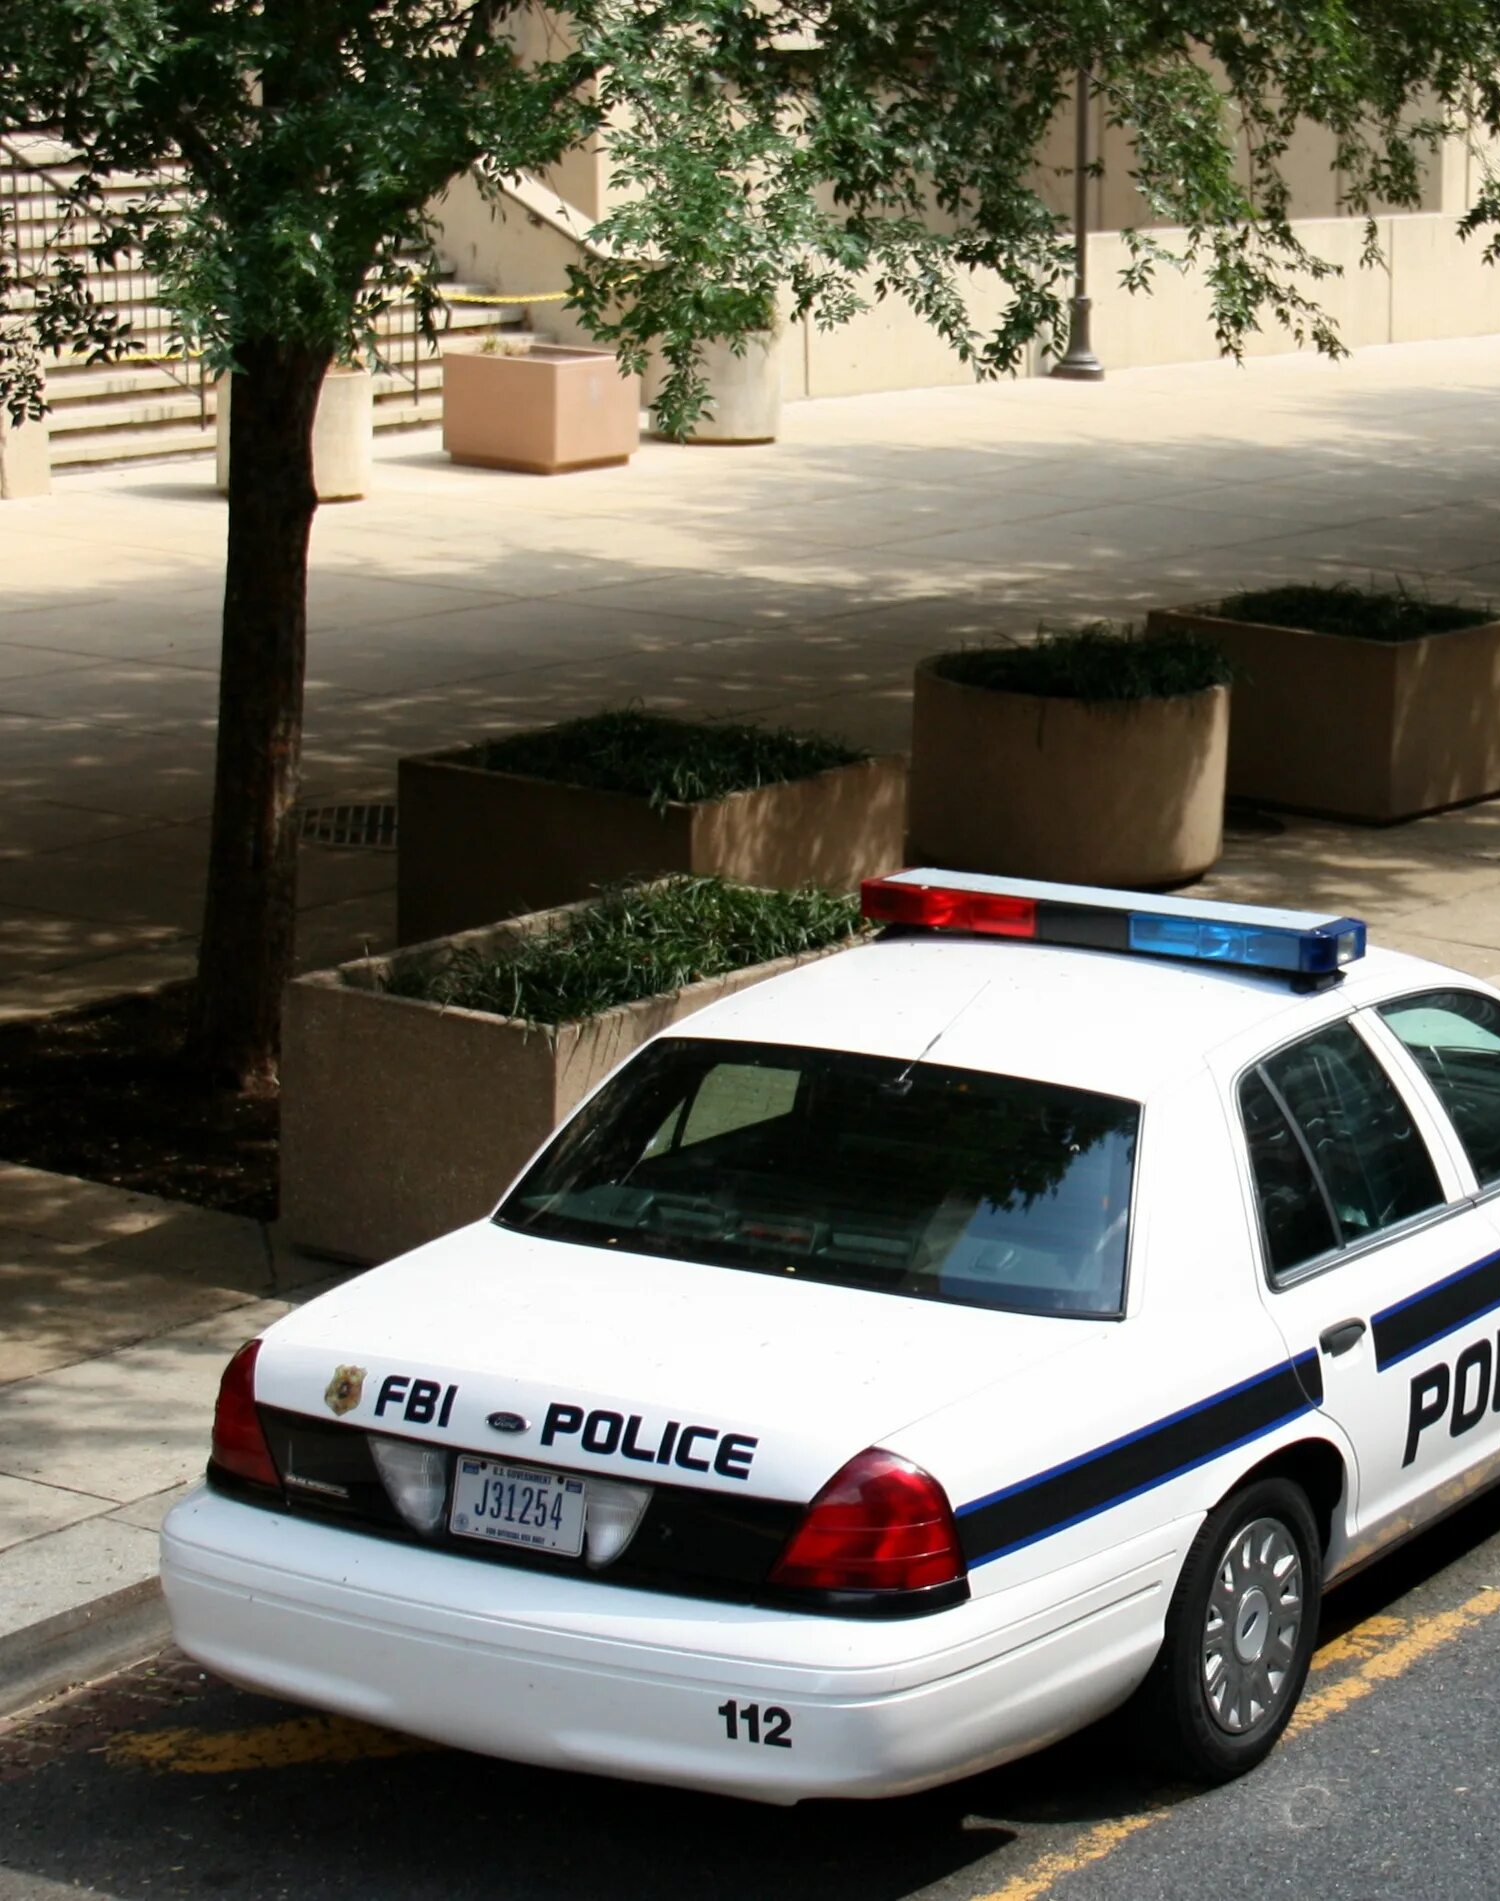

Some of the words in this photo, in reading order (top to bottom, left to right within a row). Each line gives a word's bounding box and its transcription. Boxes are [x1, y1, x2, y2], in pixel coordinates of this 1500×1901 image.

[374, 1375, 459, 1428] FBI
[540, 1401, 759, 1481] POLICE
[474, 1478, 563, 1531] J31254
[718, 1699, 792, 1748] 112
